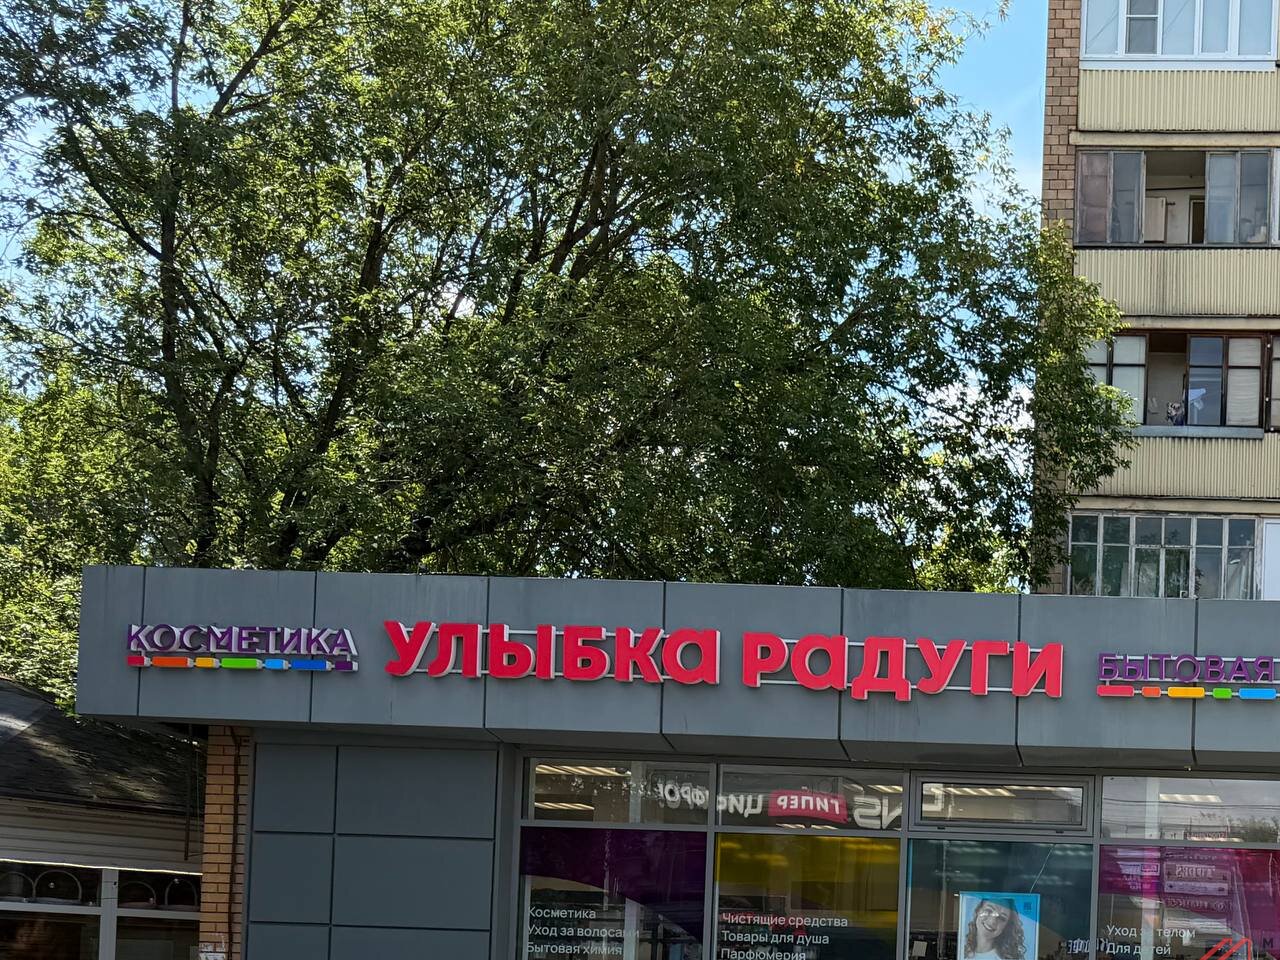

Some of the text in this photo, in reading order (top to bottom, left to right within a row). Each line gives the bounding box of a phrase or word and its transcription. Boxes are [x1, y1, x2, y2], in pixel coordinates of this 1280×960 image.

[127, 623, 357, 655] КОСМЕТИКА
[1100, 652, 1275, 685] БЫТОВАЯ
[528, 906, 597, 919] Косметика
[722, 912, 849, 928] Чистящие средства
[528, 924, 558, 937] Уход
[559, 927, 575, 936] за
[1106, 925, 1138, 938] Уход
[1157, 927, 1196, 938] телом
[721, 930, 830, 946] Товары для душа
[527, 941, 623, 955] Бытовая химия
[1105, 942, 1131, 955] Для
[1133, 944, 1171, 955] дтей
